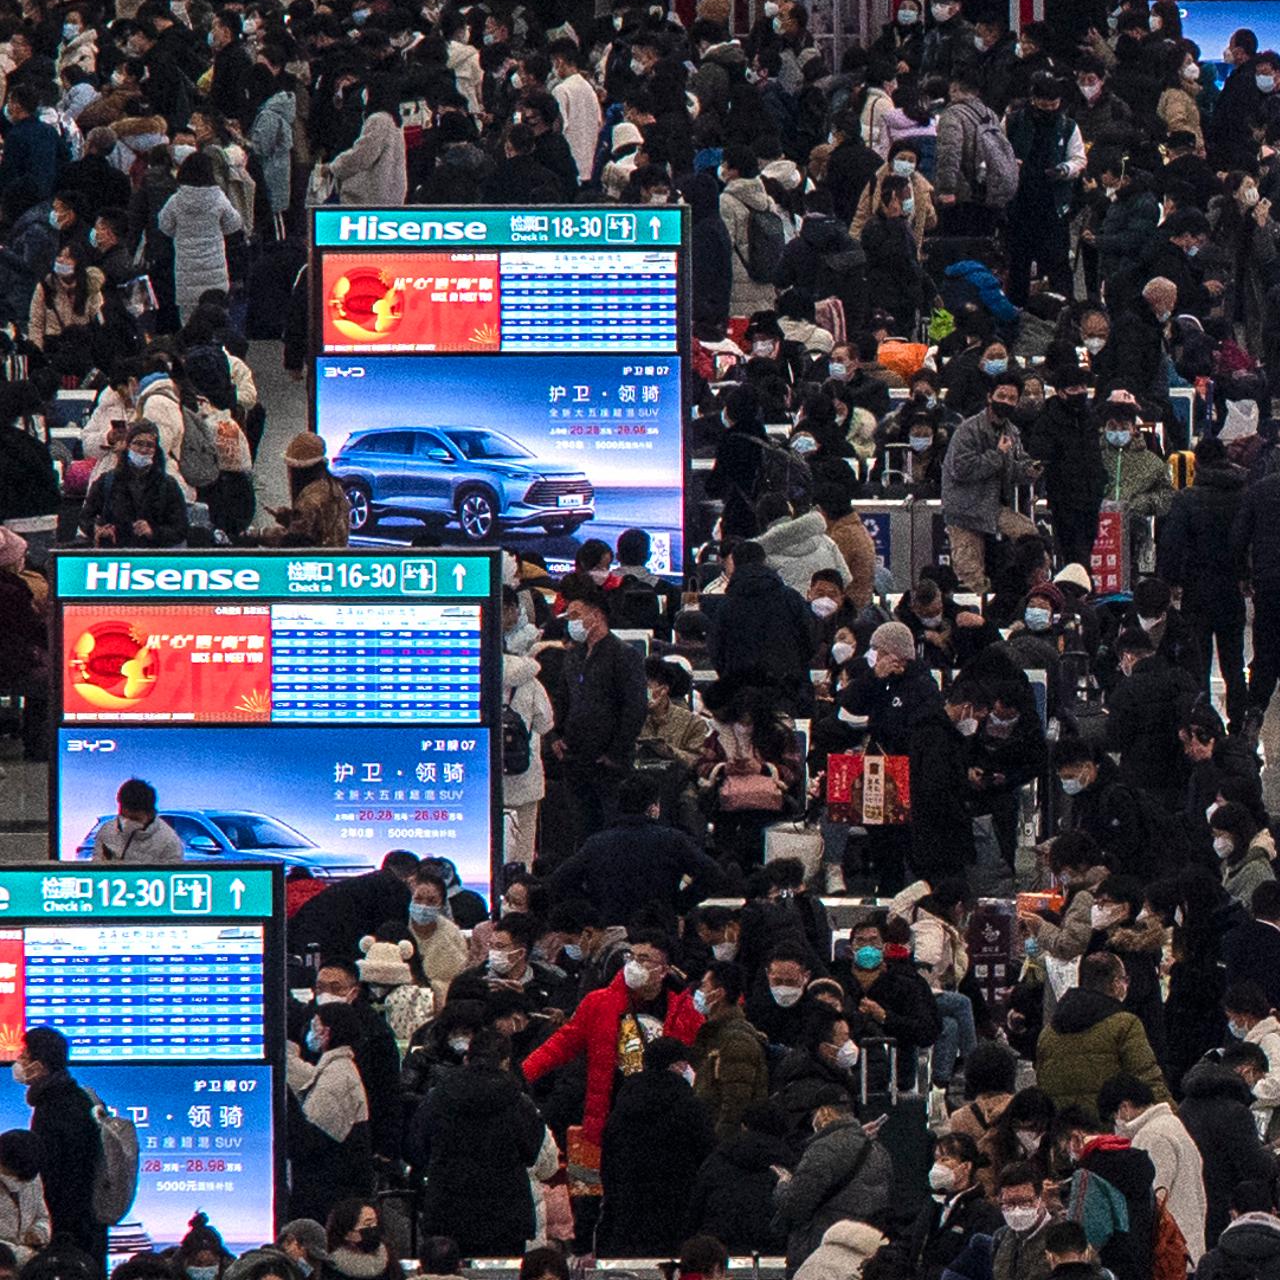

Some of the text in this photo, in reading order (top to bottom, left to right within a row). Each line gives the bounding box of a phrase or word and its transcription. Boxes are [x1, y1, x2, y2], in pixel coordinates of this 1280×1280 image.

[339, 216, 601, 240] Hisense 18-30
[656, 366, 669, 375] 07
[85, 562, 260, 590] Hisense
[337, 564, 396, 589] 16-30
[288, 582, 319, 592] Check
[67, 741, 116, 752] BYD
[460, 740, 476, 751] 07
[439, 790, 464, 800] SUV
[41, 877, 165, 907] 检票口 12-30
[43, 900, 79, 912] Check
[239, 1080, 256, 1092] 07
[215, 1137, 242, 1148] SUV
